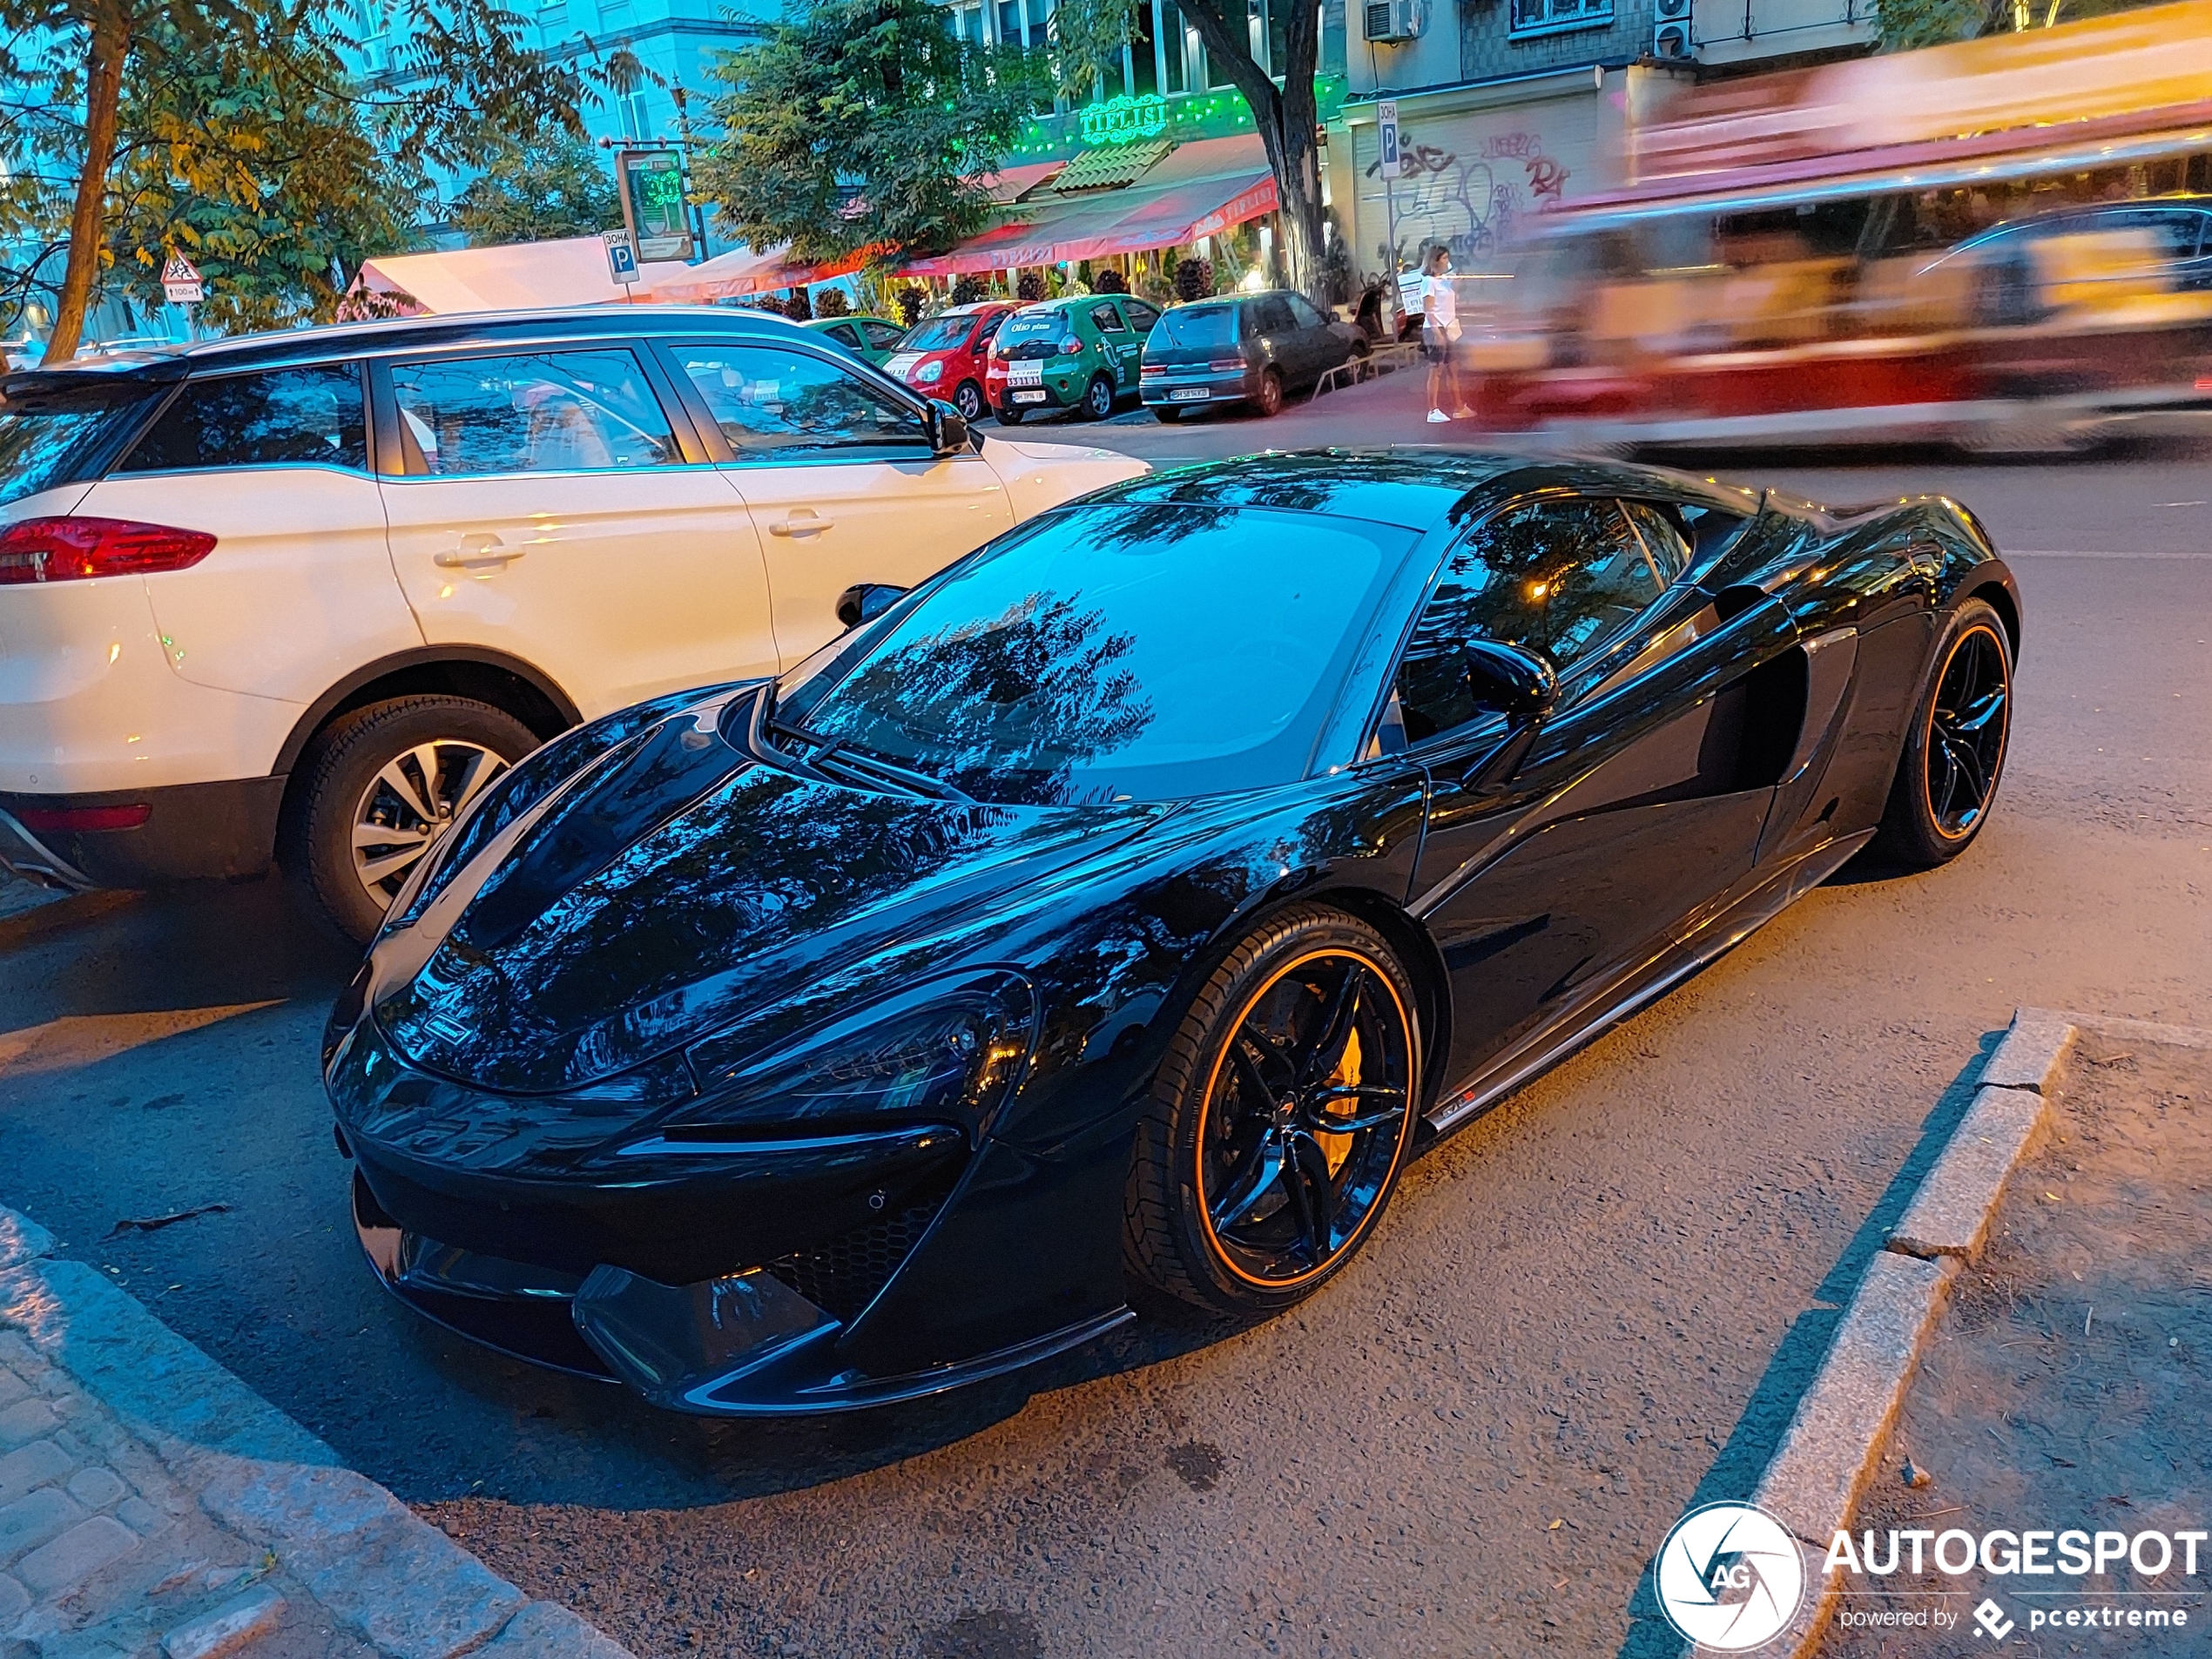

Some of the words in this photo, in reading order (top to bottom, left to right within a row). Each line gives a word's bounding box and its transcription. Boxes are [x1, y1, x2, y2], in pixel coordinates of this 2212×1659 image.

[1080, 105, 1166, 134] TIFLISI
[1380, 105, 1396, 119] ЗОНА
[1386, 128, 1394, 159] P
[1224, 186, 1272, 220] TIFLISI
[606, 232, 631, 245] ЗОНА
[616, 248, 629, 271] P
[1019, 376, 1029, 385] 11
[1030, 375, 1041, 384] 11
